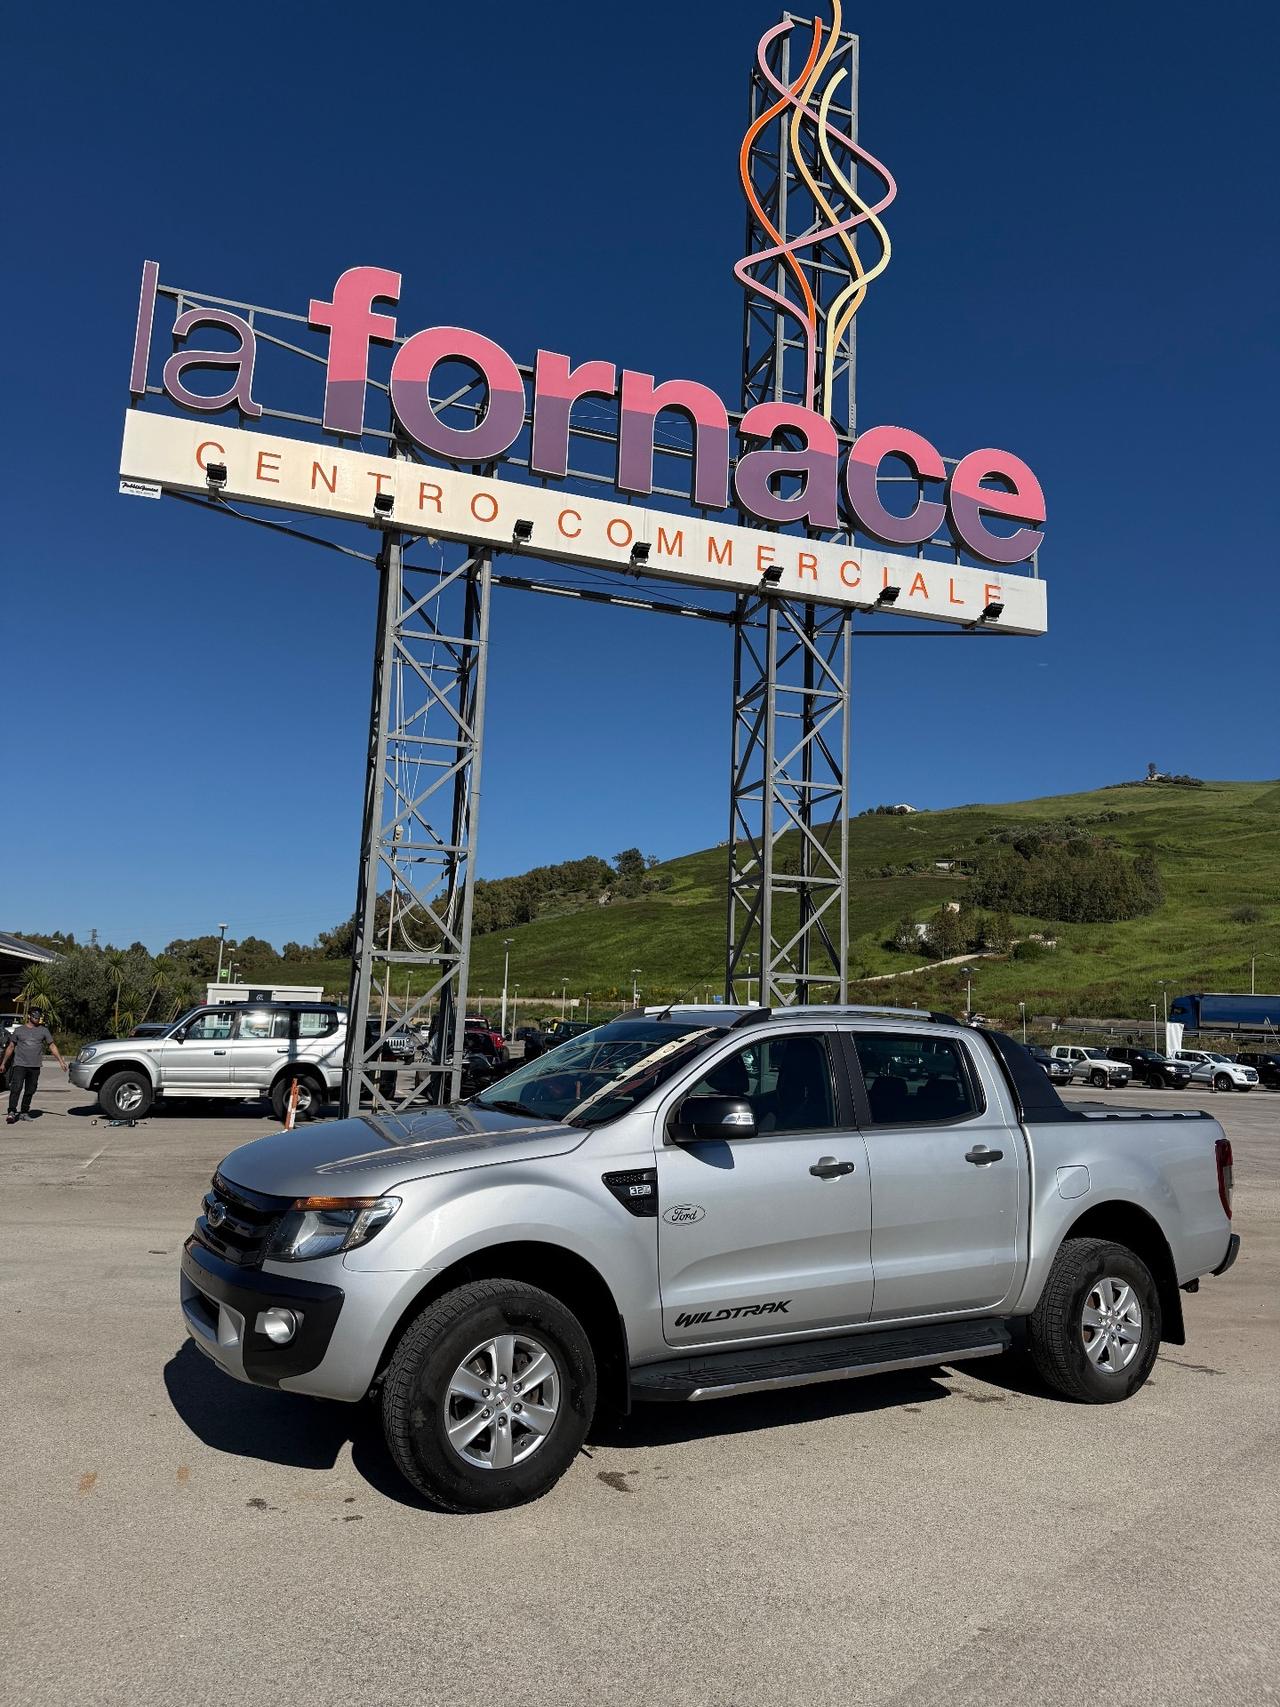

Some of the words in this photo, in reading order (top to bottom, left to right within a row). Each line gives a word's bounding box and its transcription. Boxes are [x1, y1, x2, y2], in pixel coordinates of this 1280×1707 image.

[129, 260, 262, 417] la
[308, 266, 1047, 564] fornace
[195, 441, 500, 523] CENTRO
[557, 509, 1004, 609] COMMERCIALE
[671, 1206, 698, 1222] Ford
[674, 1299, 793, 1328] WILDTRAK
